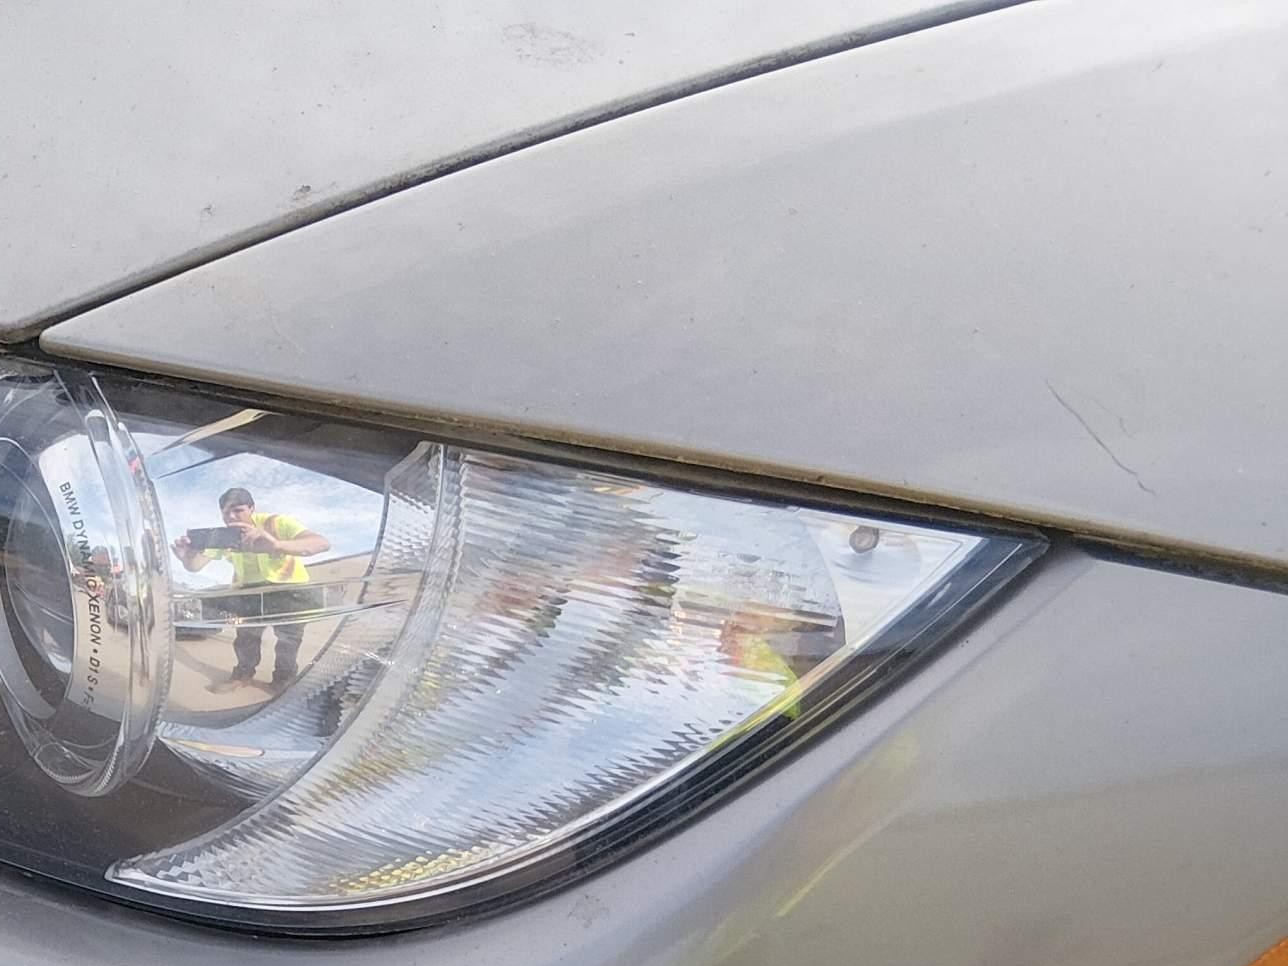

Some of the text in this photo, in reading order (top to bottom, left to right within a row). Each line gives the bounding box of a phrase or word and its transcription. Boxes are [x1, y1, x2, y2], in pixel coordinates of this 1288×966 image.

[59, 481, 81, 516] BMW
[72, 519, 98, 591] DYNAMIC
[88, 591, 102, 645] XENON
